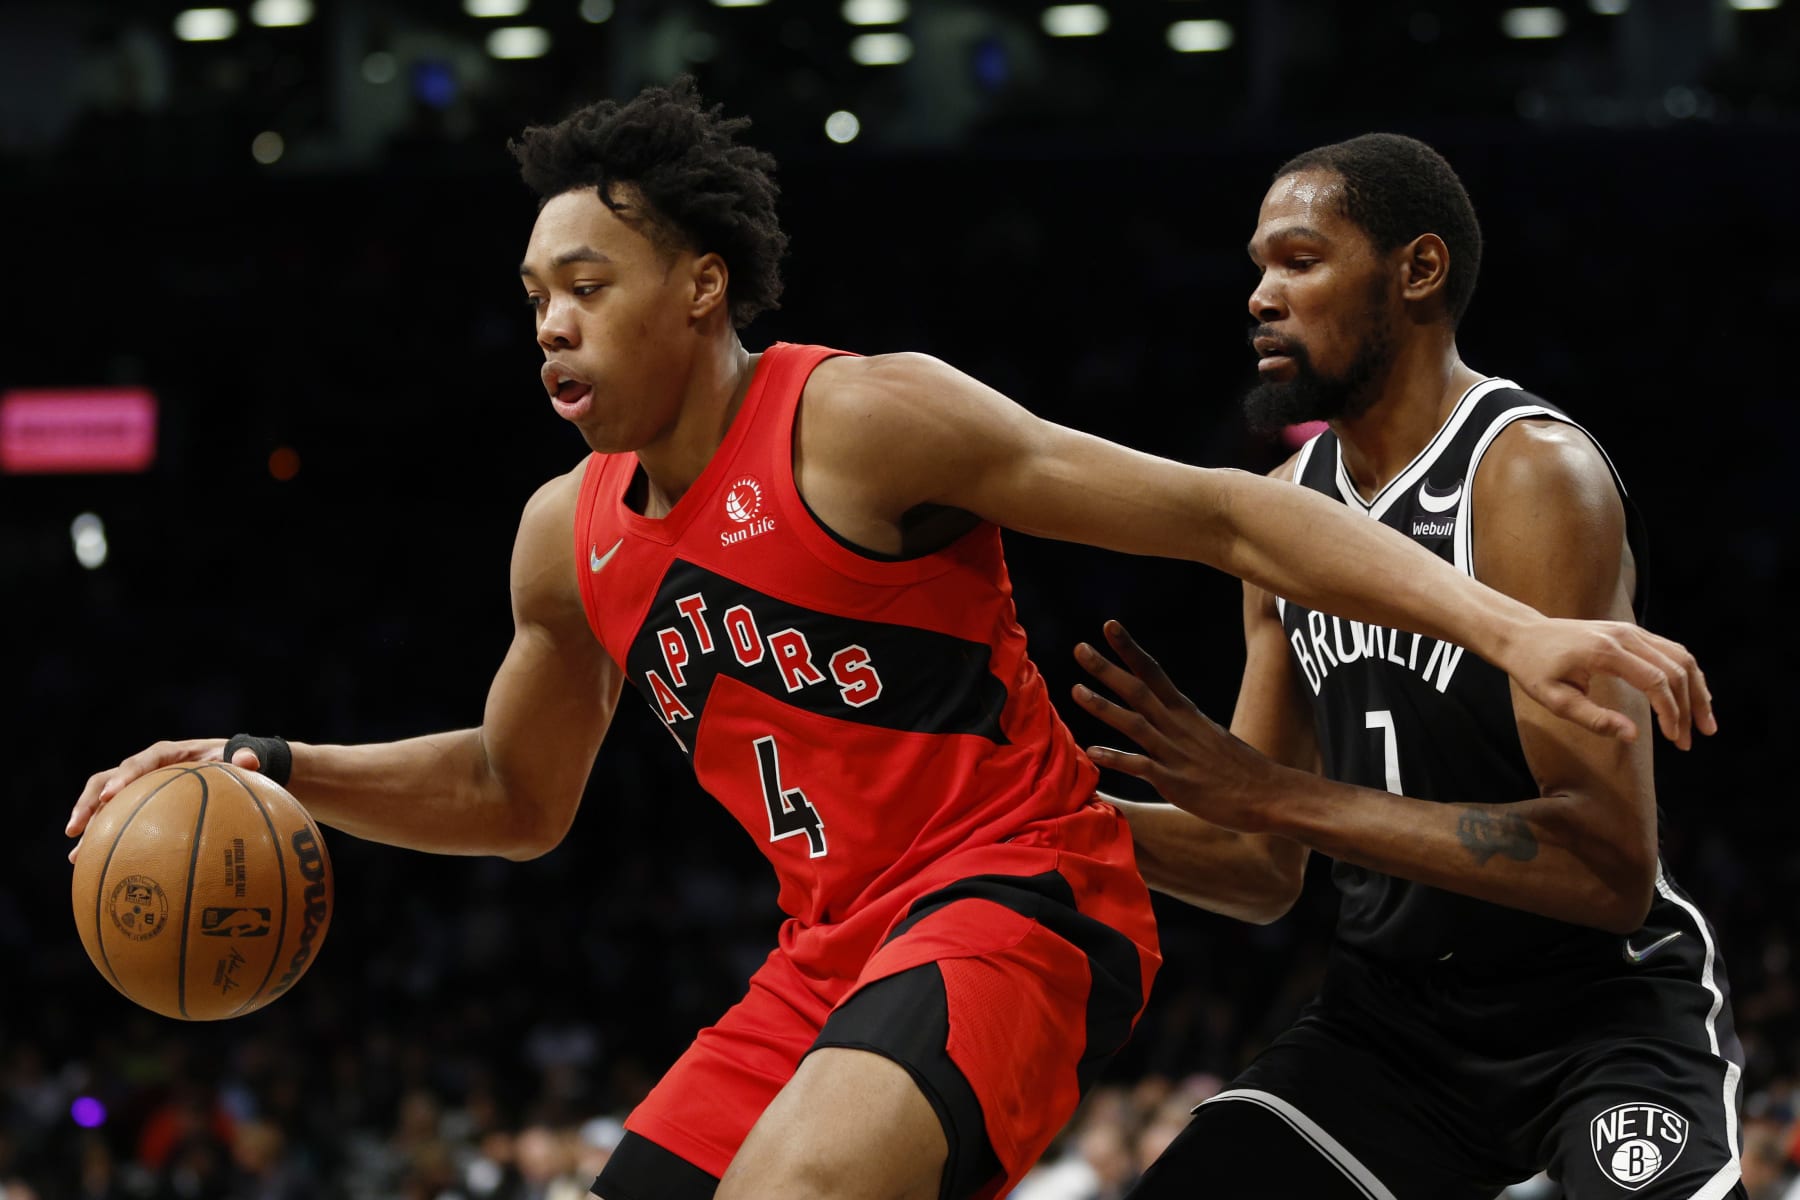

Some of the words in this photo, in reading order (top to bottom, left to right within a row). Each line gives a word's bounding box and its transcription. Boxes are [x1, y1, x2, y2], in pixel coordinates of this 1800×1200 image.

[720, 529, 747, 547] Sun
[749, 516, 775, 537] Life
[1412, 521, 1454, 536] Webull
[644, 592, 883, 753] APTORS
[1365, 709, 1403, 796] 7
[752, 735, 828, 859] 4
[1596, 1106, 1682, 1152] NETS
[1629, 1145, 1644, 1177] B
